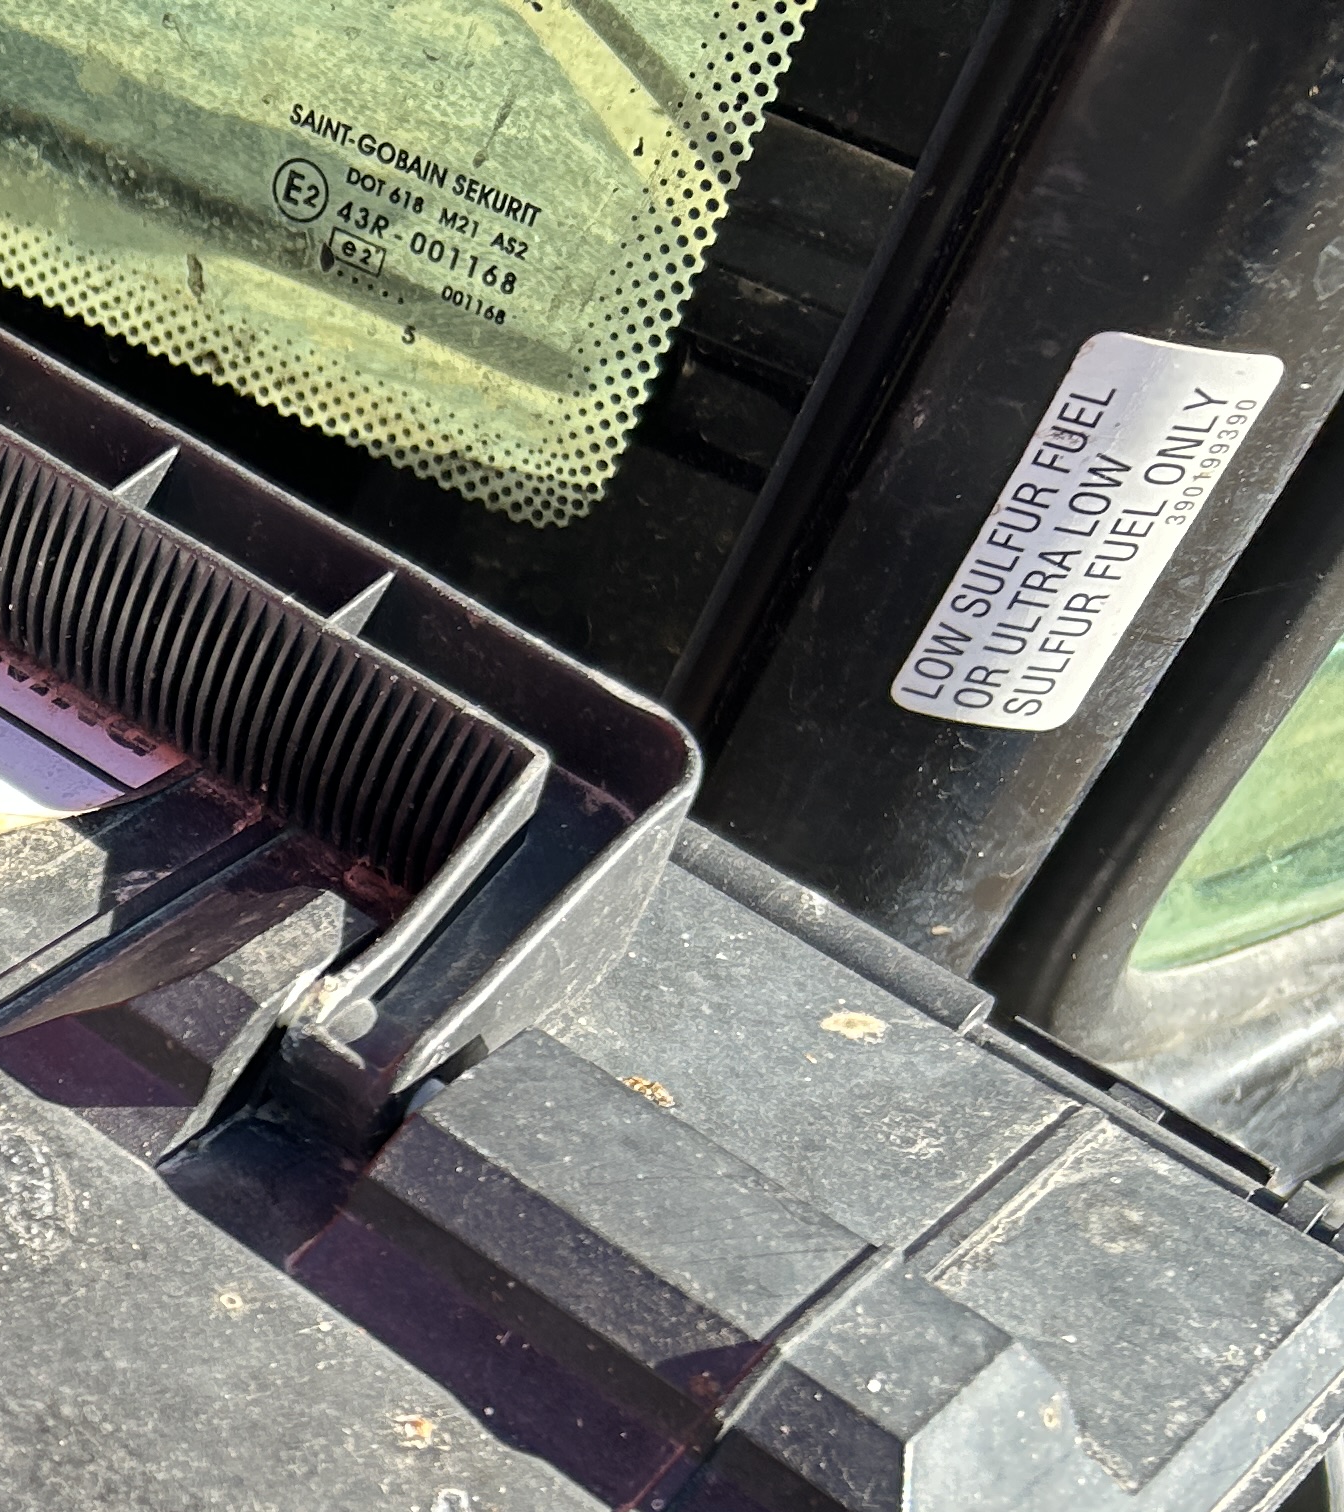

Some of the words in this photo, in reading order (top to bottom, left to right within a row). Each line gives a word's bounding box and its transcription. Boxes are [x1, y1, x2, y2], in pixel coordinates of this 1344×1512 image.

[282, 169, 320, 209] E2
[289, 103, 449, 189] SAINT-GOBAIN
[452, 174, 542, 228] SEKURIT
[346, 167, 387, 197] DOT
[389, 186, 425, 214] 618
[438, 207, 480, 239] M21
[490, 232, 529, 261] AS2
[341, 238, 373, 265] e2
[441, 285, 506, 325] 001168
[901, 622, 972, 699] LOW
[951, 482, 1060, 618] SULFUR
[1032, 388, 1117, 473] FUEL
[953, 665, 1009, 710] OR
[984, 549, 1082, 655] ULTRA
[1055, 452, 1132, 537] LOW
[1003, 592, 1110, 716] SULFUR
[1085, 499, 1169, 580] FUEL
[1144, 387, 1228, 486] ONLY
